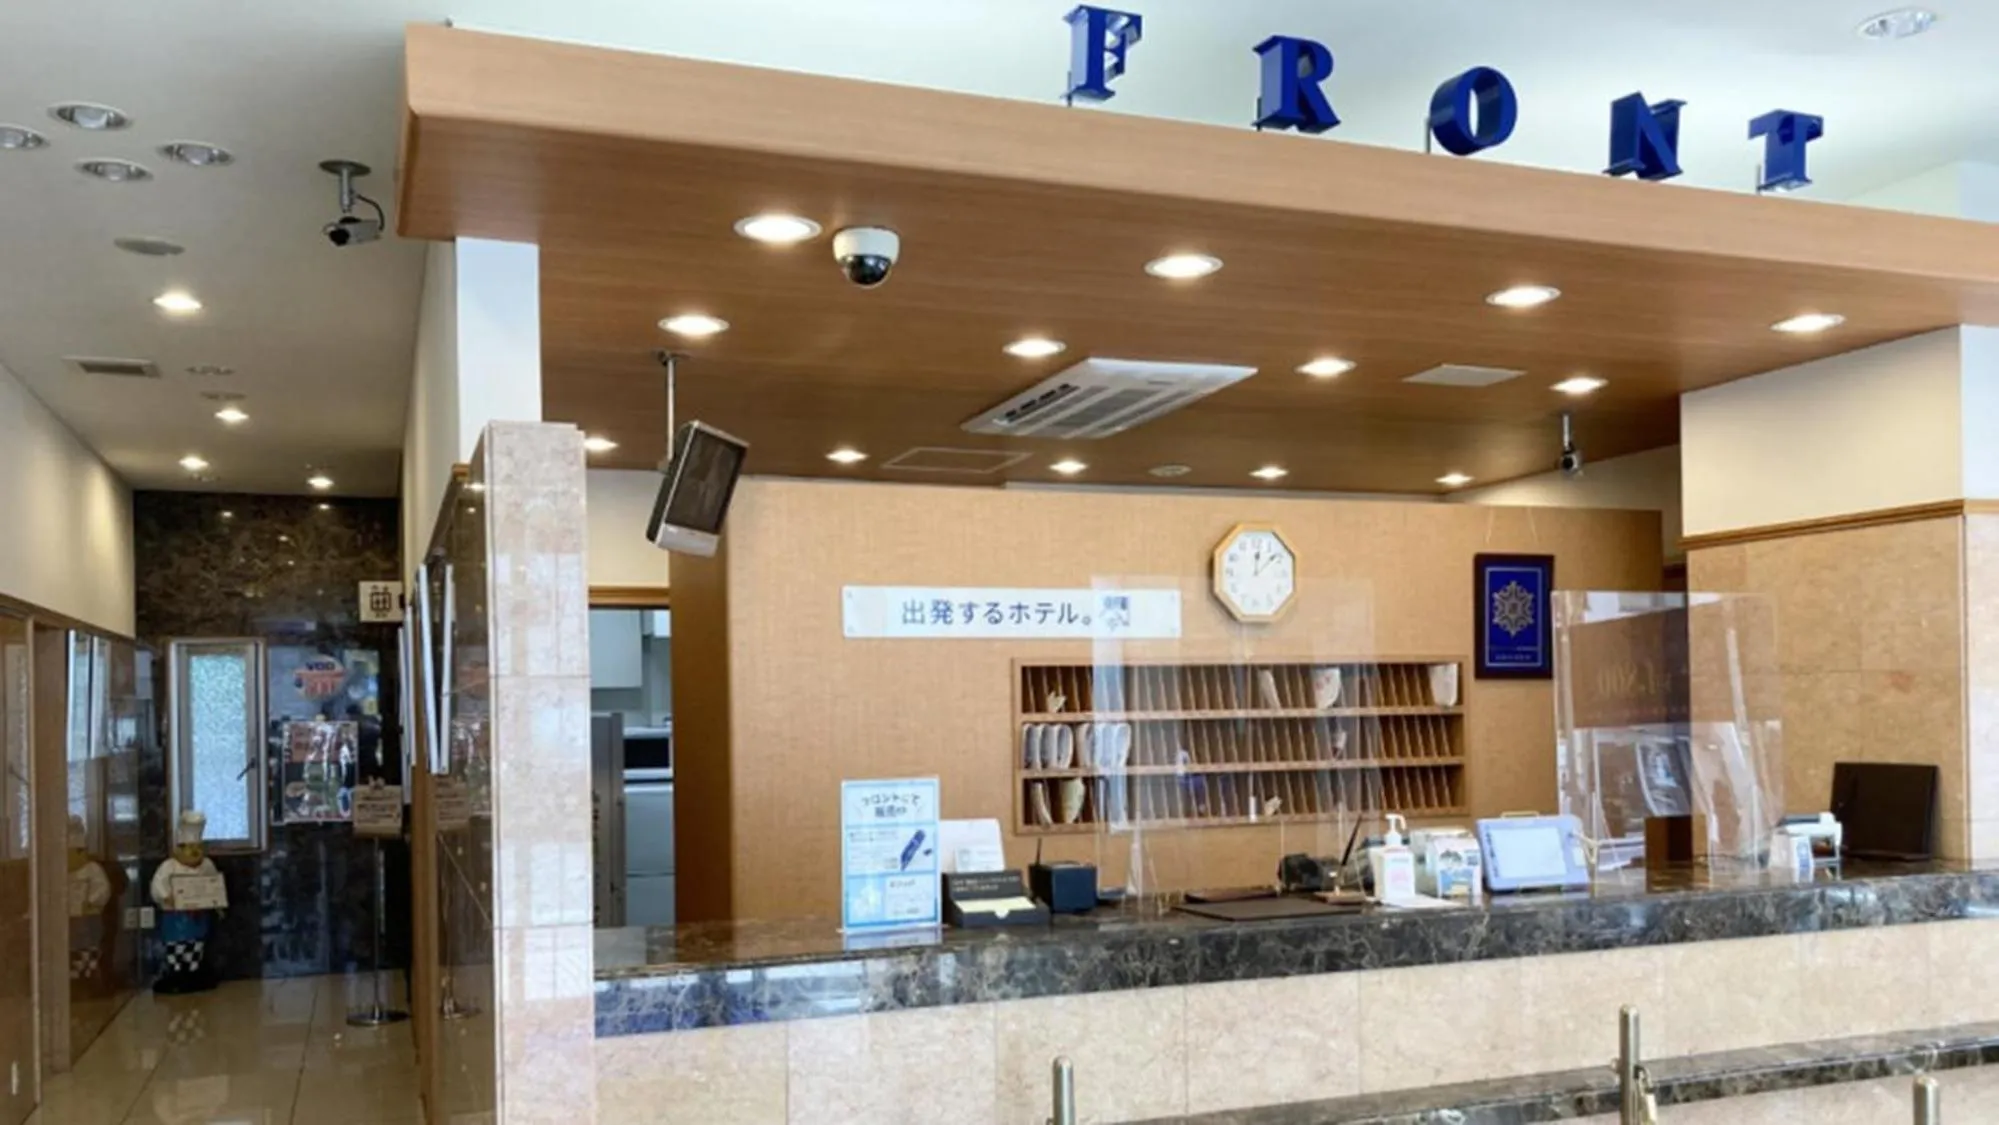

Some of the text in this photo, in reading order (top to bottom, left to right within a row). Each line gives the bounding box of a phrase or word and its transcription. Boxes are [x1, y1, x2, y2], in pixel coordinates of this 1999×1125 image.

[1064, 4, 1825, 192] FRONT
[902, 598, 1092, 627] 出発するホテル。
